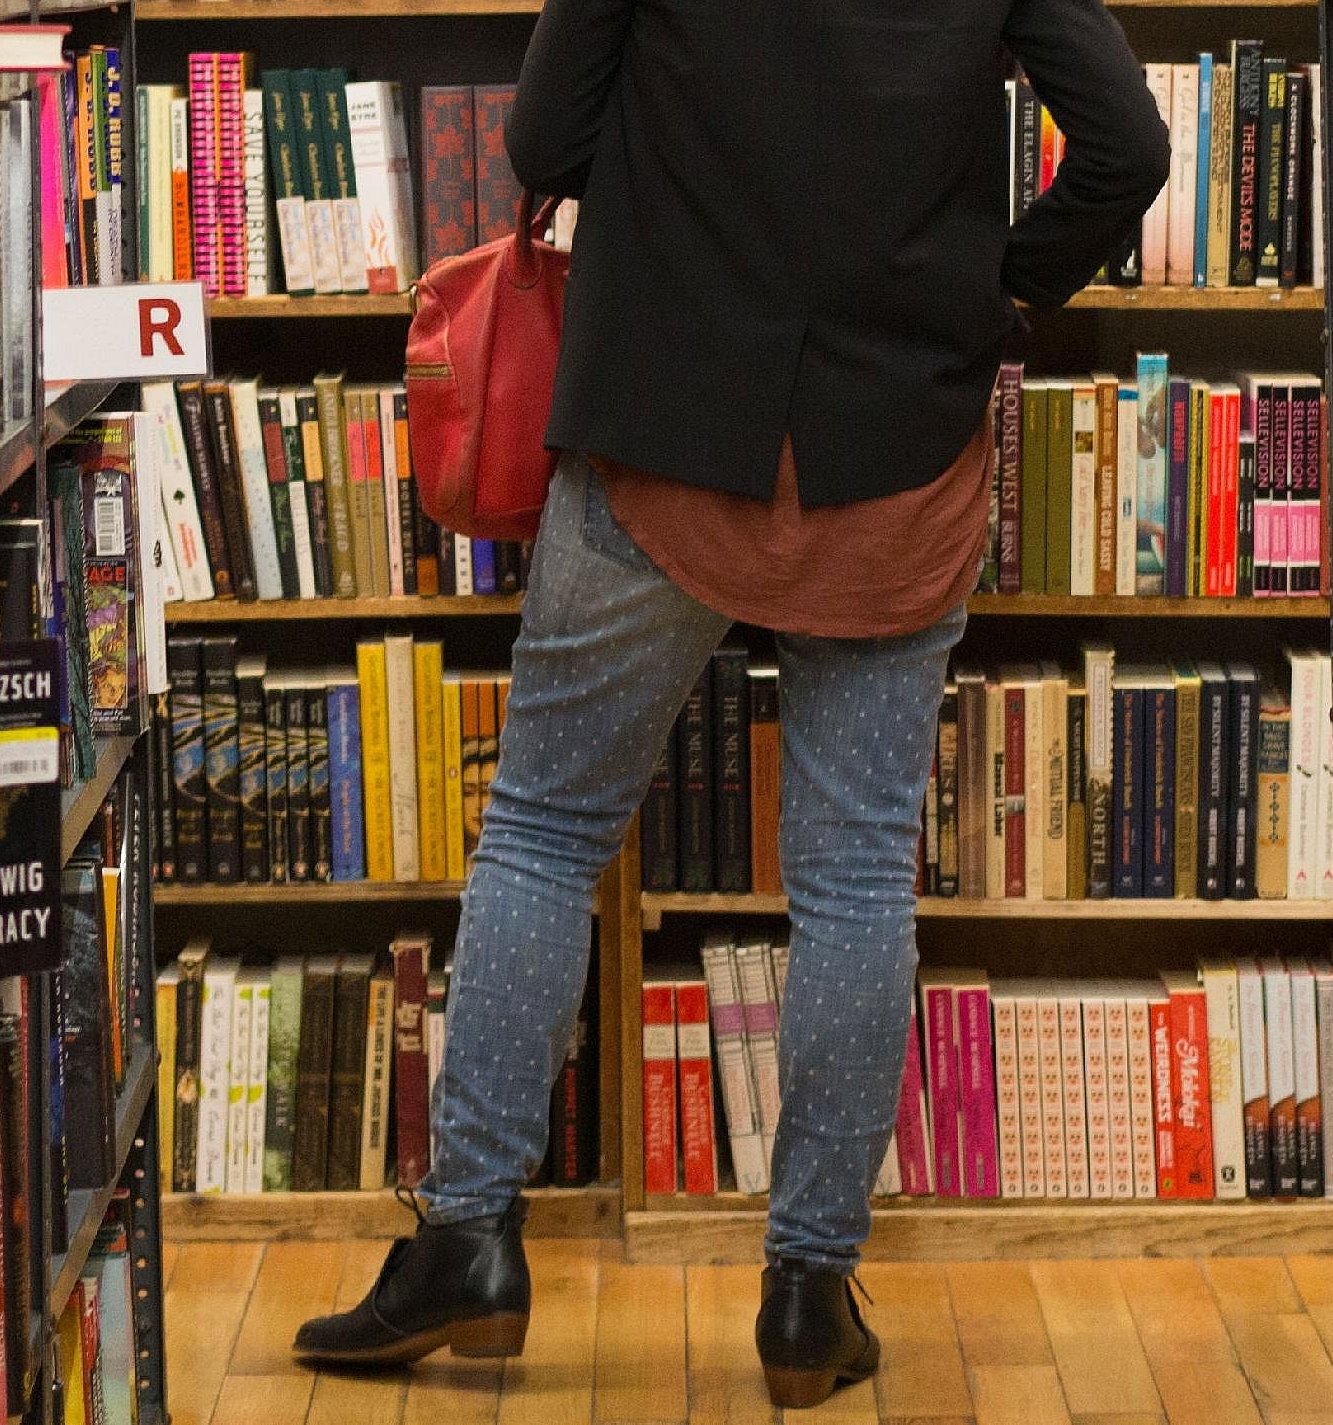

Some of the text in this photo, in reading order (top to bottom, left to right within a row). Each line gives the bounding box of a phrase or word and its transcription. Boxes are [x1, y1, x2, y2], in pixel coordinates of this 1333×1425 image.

[351, 102, 376, 111] JANE
[1242, 124, 1254, 152] THE
[1289, 95, 1298, 155] CLOCKWORK
[108, 119, 120, 176] ROBB
[1023, 101, 1035, 184] THE ELAGIN
[245, 112, 263, 281] SAVE YOURSELF
[1287, 159, 1295, 200] ORANGE
[1239, 208, 1253, 251] MODE
[138, 298, 185, 356] R
[1002, 380, 1018, 511] HOUSES WEST
[1293, 400, 1304, 489] SELLEVISION
[1307, 399, 1318, 488] SELLEVISION
[1002, 520, 1014, 563] BURNS
[1100, 465, 1113, 571] LEAVING COLD SASSY
[723, 697, 738, 724] THE
[994, 752, 1004, 837] Manual Labor
[1092, 793, 1106, 866] NORTH
[1155, 1027, 1171, 1123] WEIRDNESS
